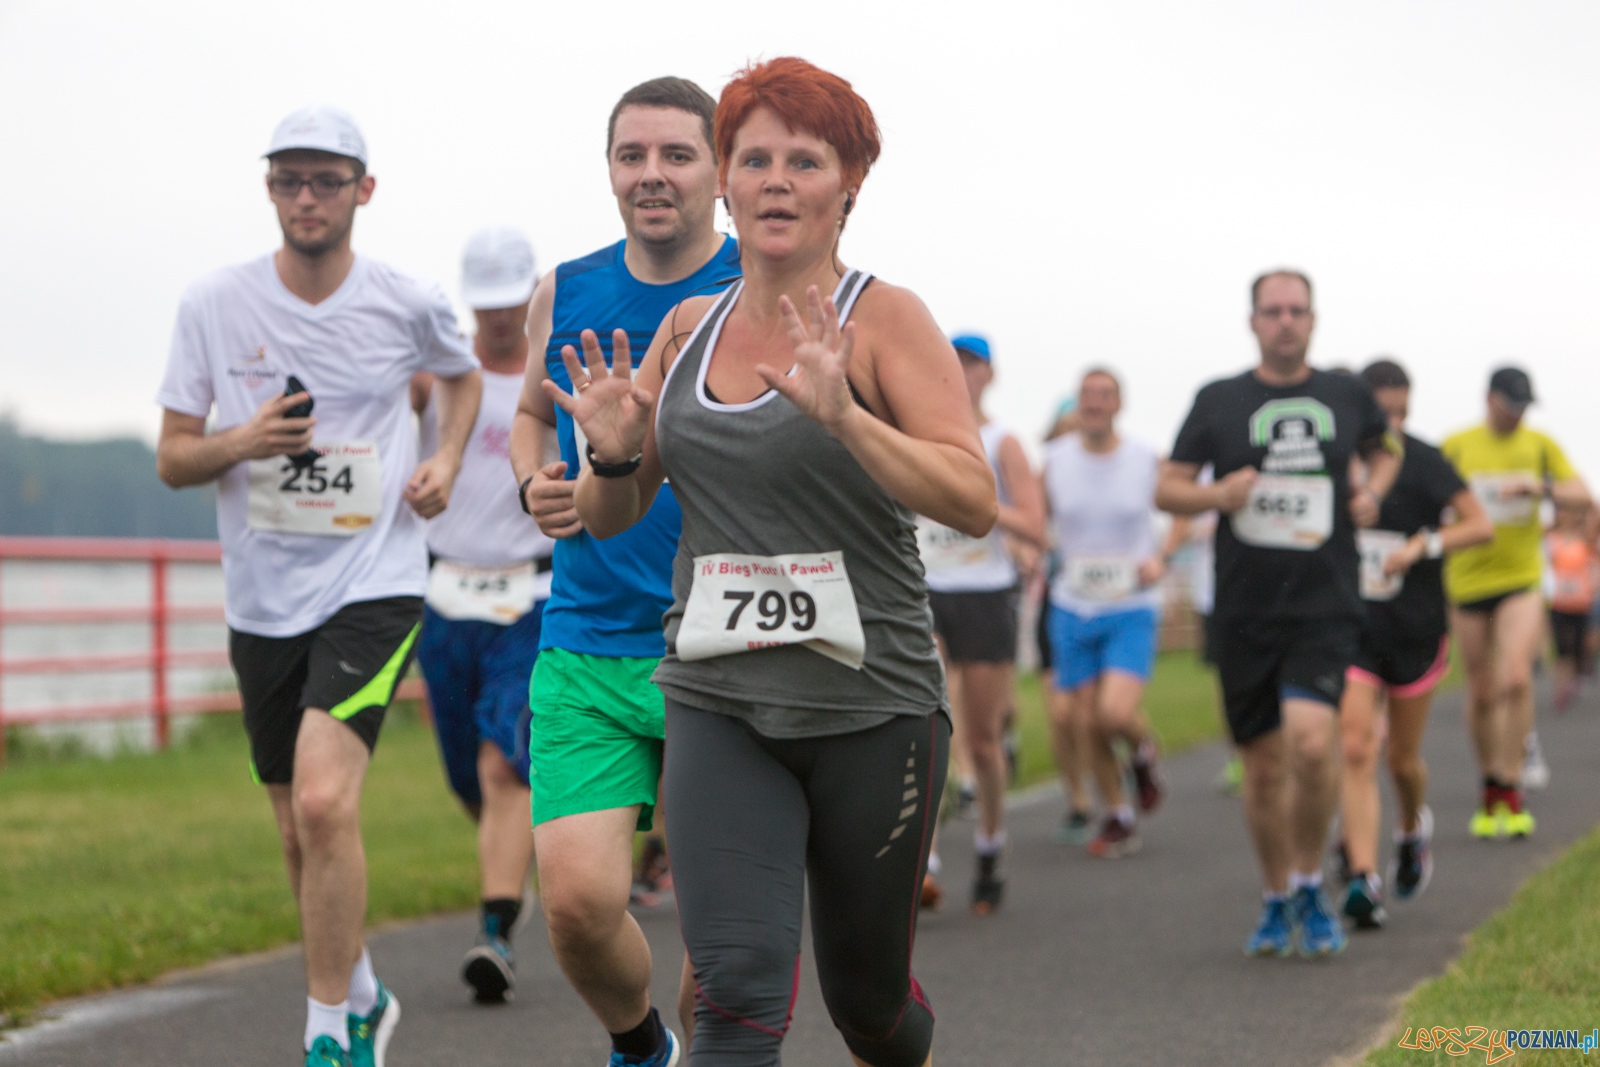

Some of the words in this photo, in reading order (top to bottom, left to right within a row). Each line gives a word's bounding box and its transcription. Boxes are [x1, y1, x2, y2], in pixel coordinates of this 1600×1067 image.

[279, 463, 354, 494] 254
[702, 563, 715, 576] IV
[719, 562, 751, 577] Bieg
[790, 561, 834, 576] Paweł
[723, 589, 817, 632] 799
